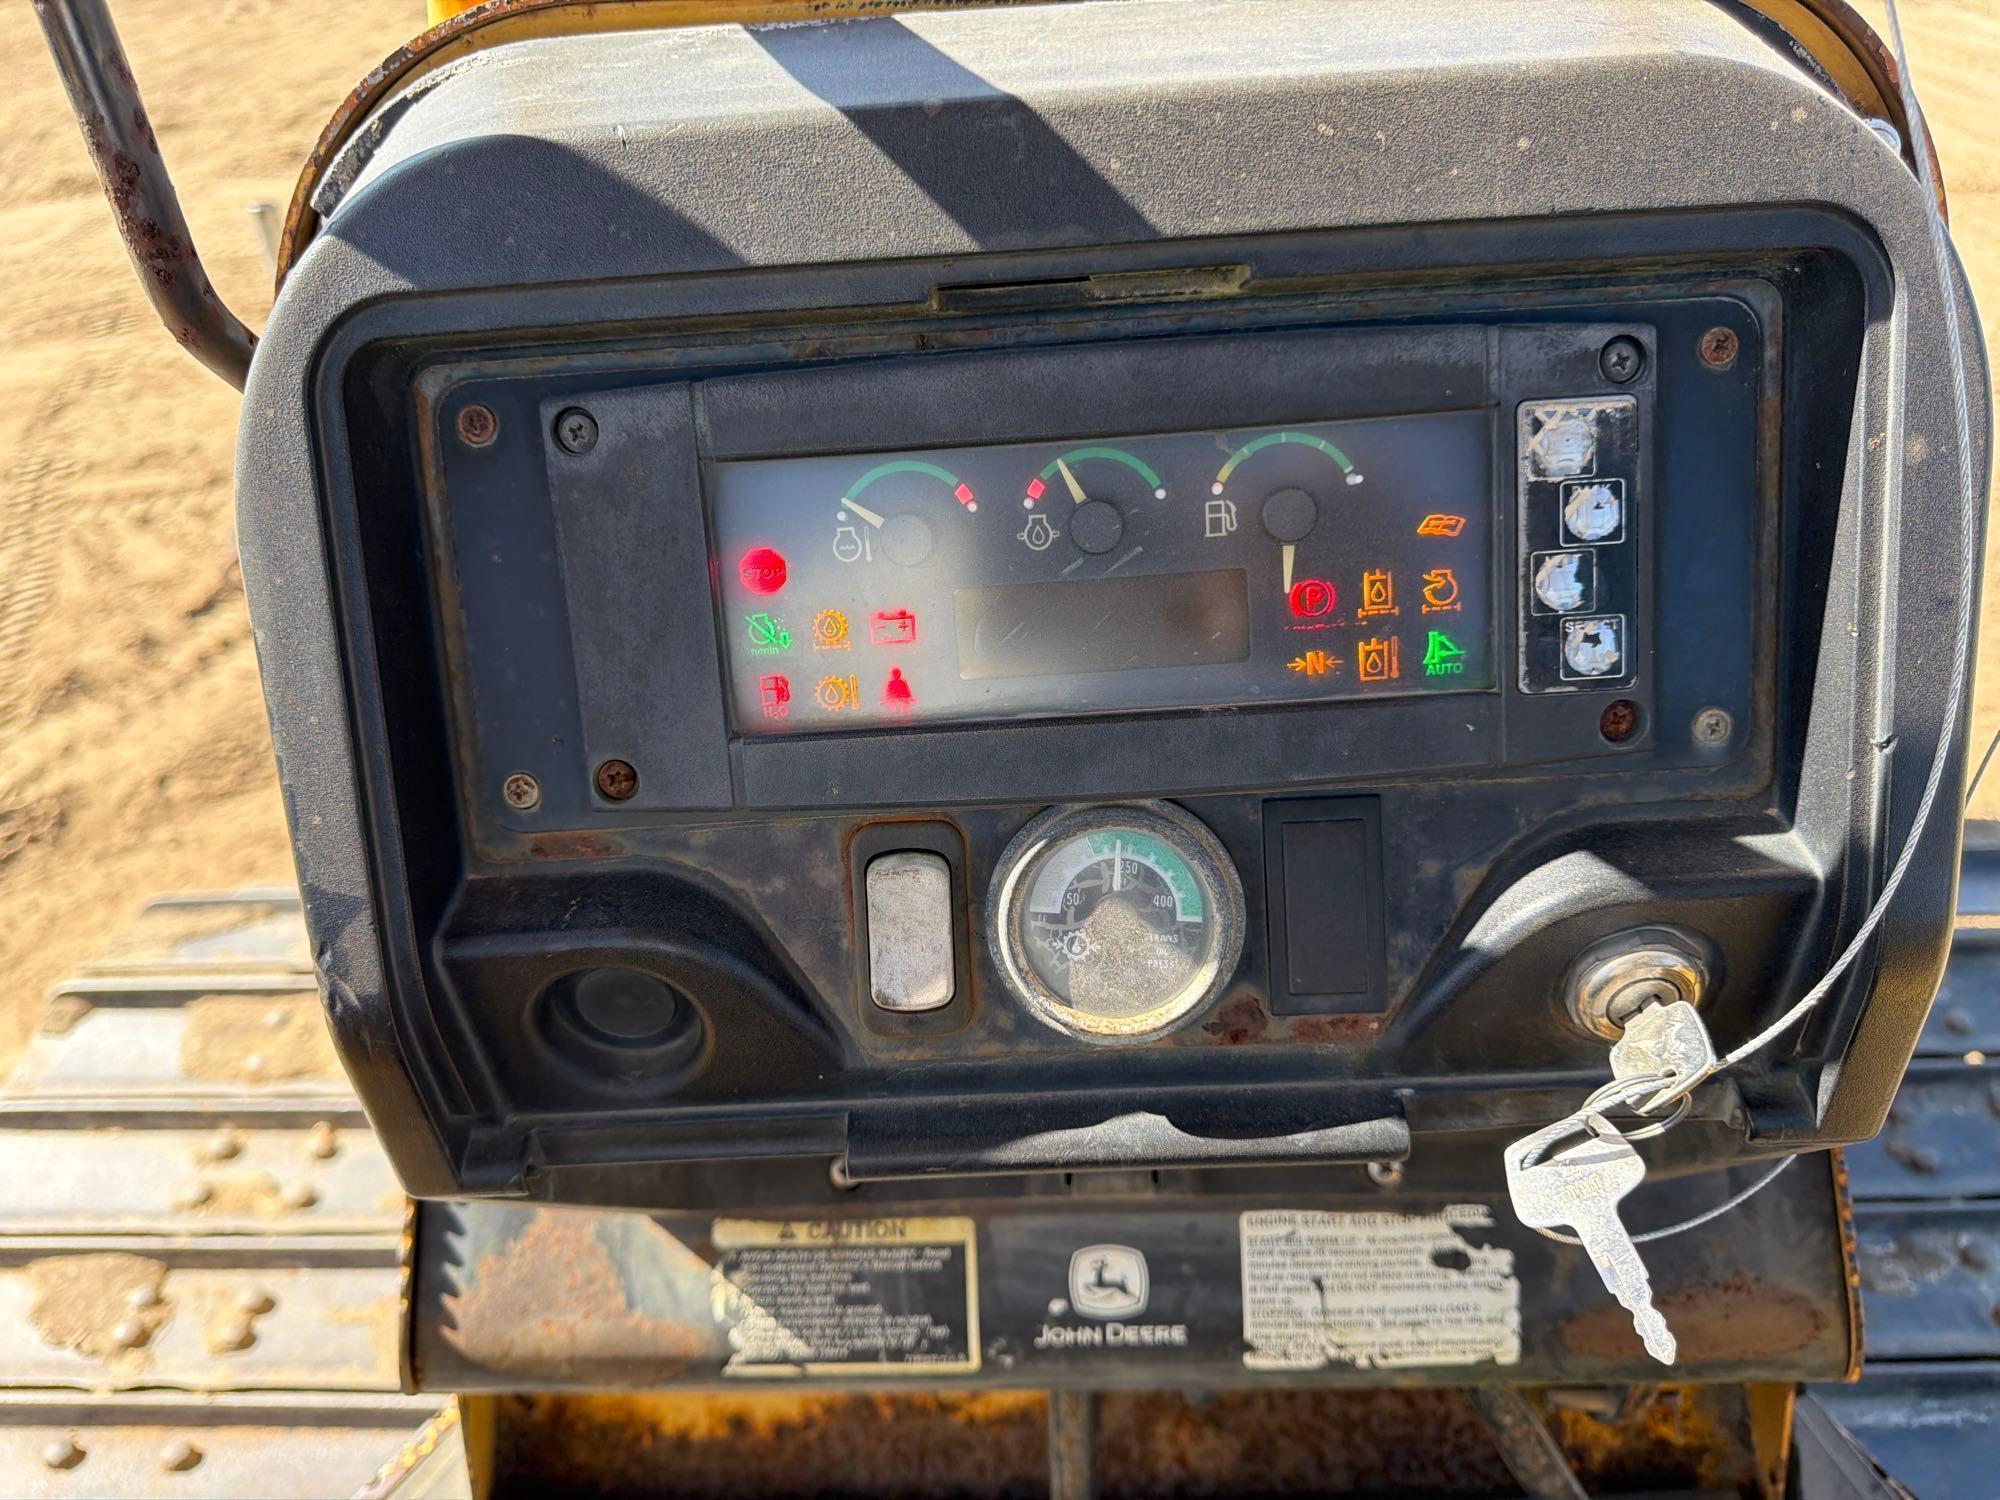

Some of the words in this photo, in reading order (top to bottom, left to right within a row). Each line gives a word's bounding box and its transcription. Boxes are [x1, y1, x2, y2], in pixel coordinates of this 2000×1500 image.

[743, 566, 785, 579] STOP
[1306, 651, 1326, 676] N
[1425, 661, 1464, 676] AUTO
[1119, 860, 1138, 874] 250
[1066, 892, 1080, 905] 50
[1152, 895, 1173, 908] 400
[807, 1219, 907, 1240] CAUTION
[1034, 1322, 1103, 1349] JOHN
[1105, 1321, 1190, 1347] DEERE
